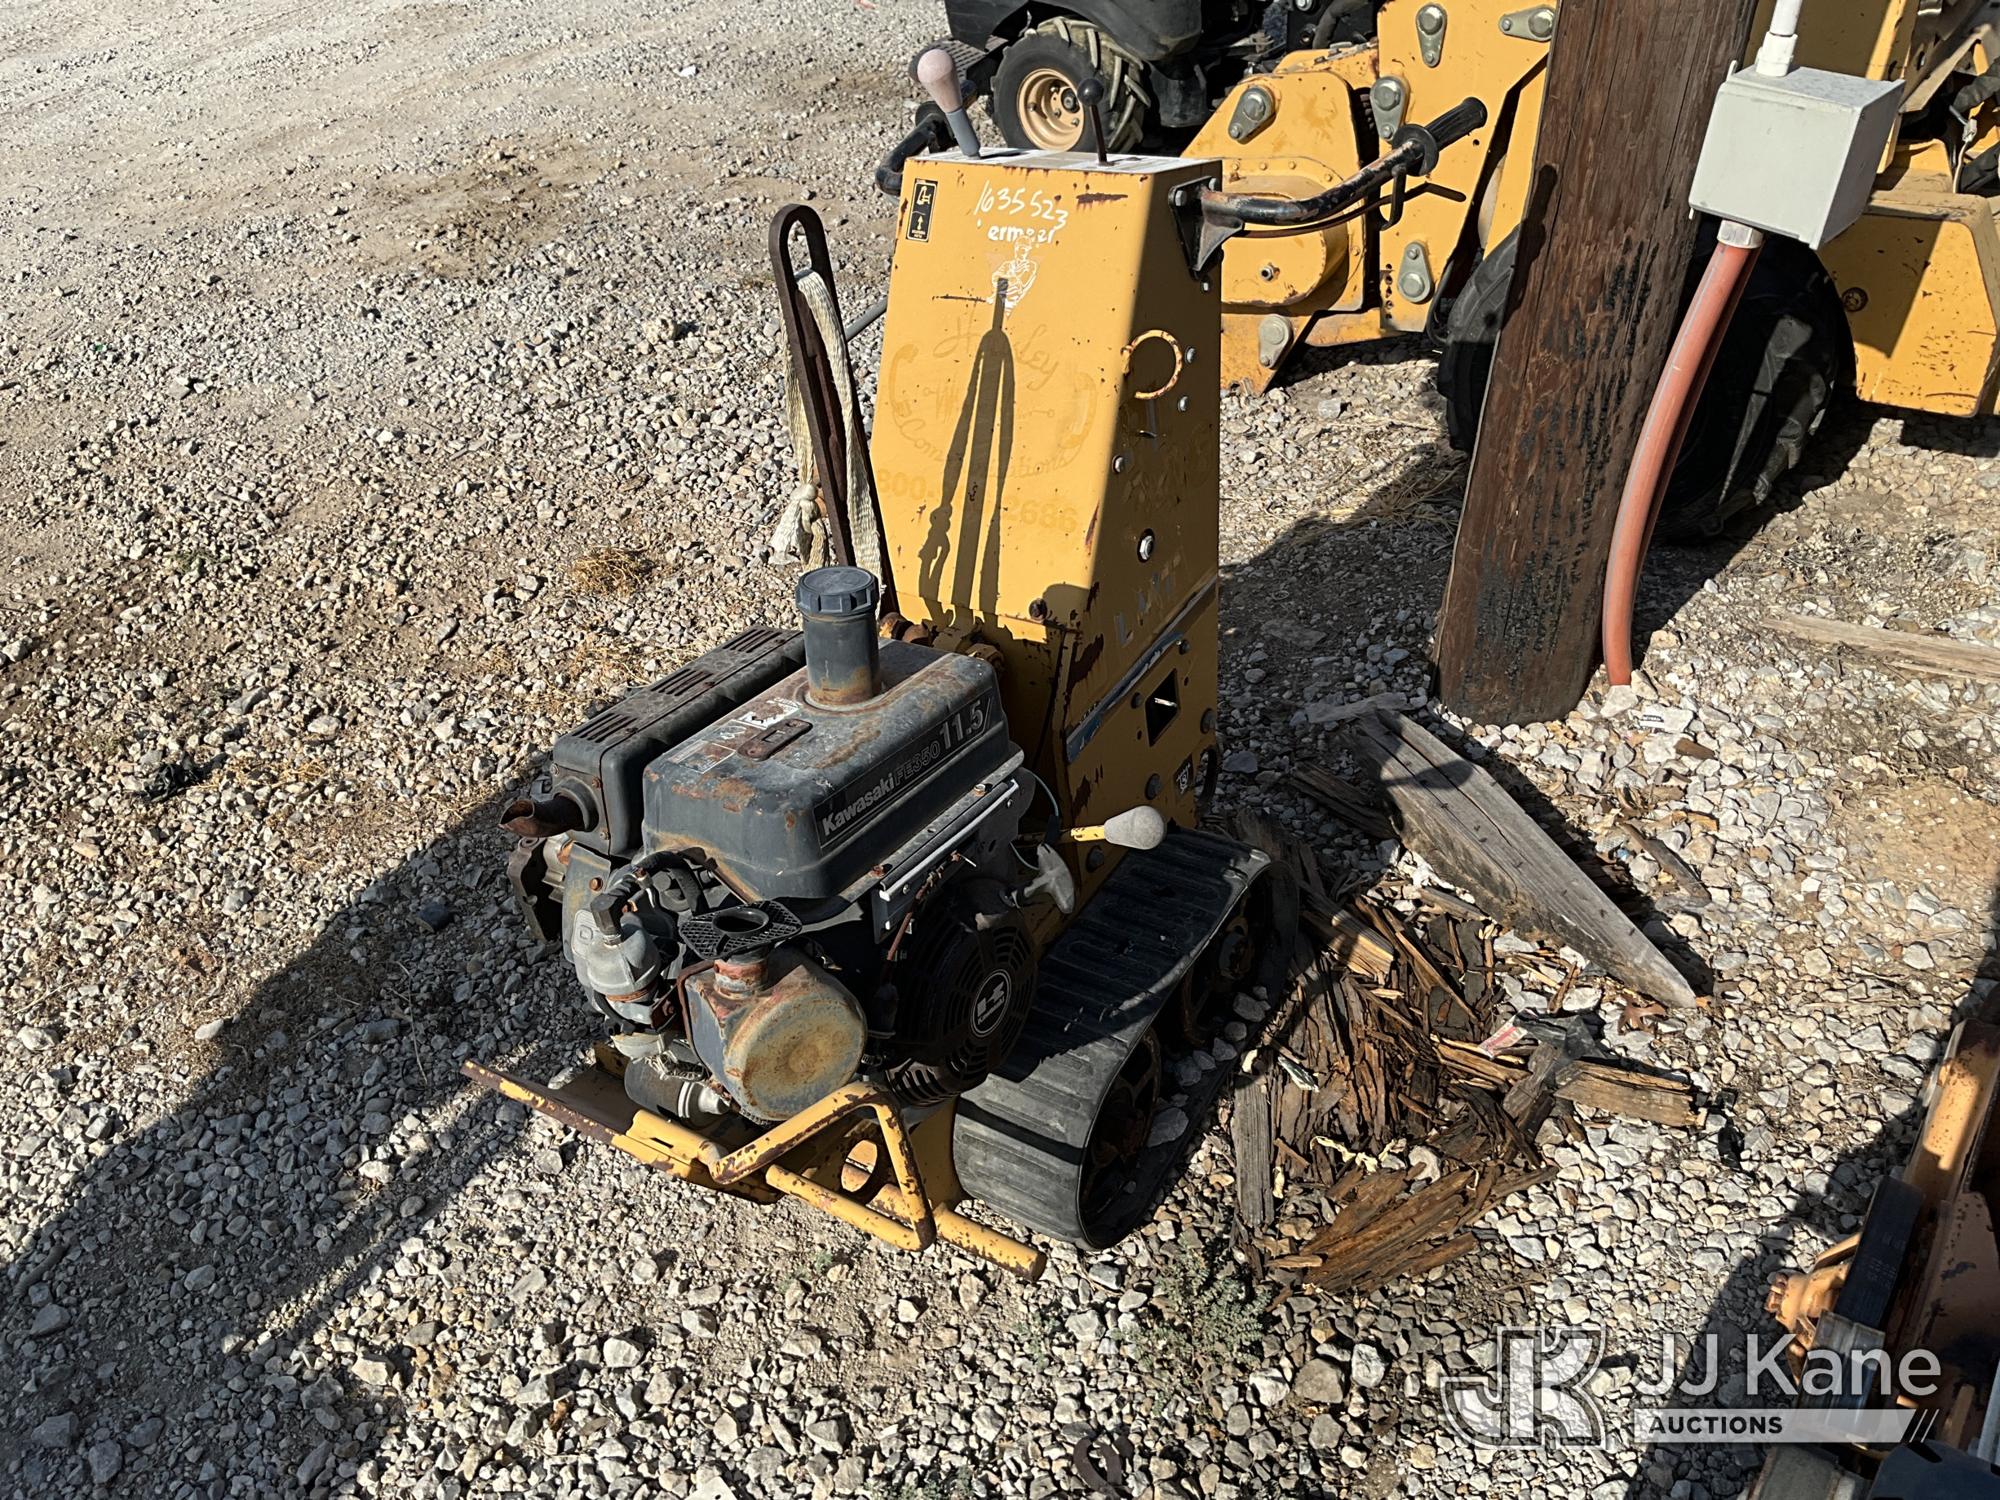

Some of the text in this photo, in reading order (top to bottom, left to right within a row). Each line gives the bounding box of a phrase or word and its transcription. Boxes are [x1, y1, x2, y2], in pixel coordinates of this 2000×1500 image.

[821, 699, 984, 836] Kawasaki FE350 11.5
